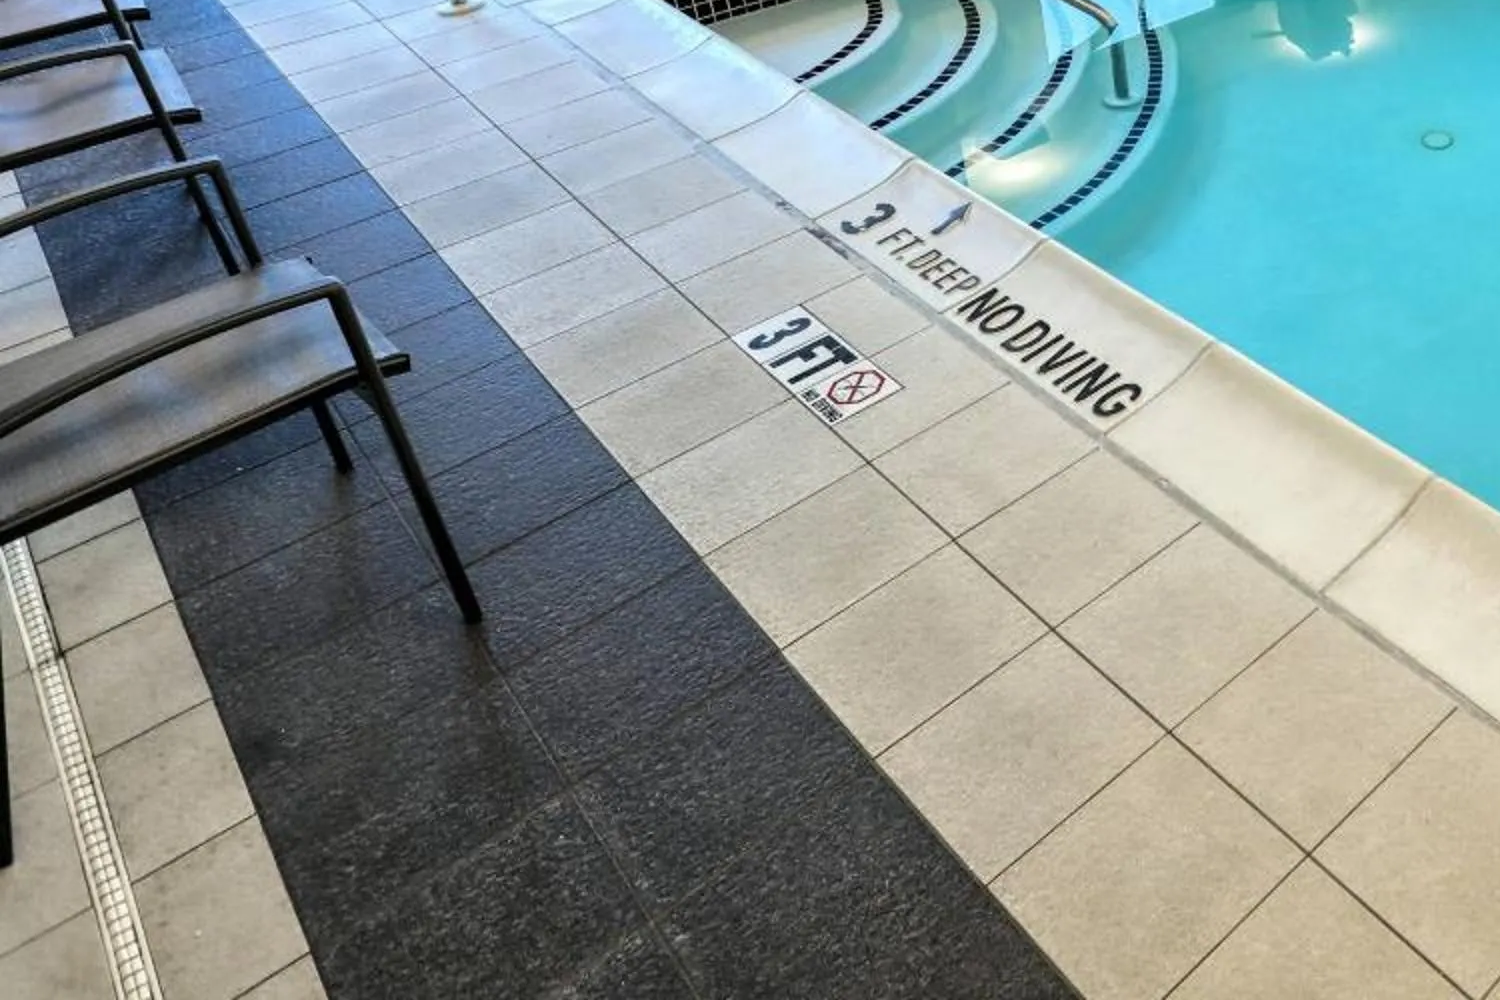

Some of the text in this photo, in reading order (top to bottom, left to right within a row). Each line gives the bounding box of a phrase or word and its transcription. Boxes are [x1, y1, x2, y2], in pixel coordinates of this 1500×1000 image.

[749, 318, 858, 384] 3 FT
[841, 203, 1142, 417] 3 FT. DEEP NO DIVING
